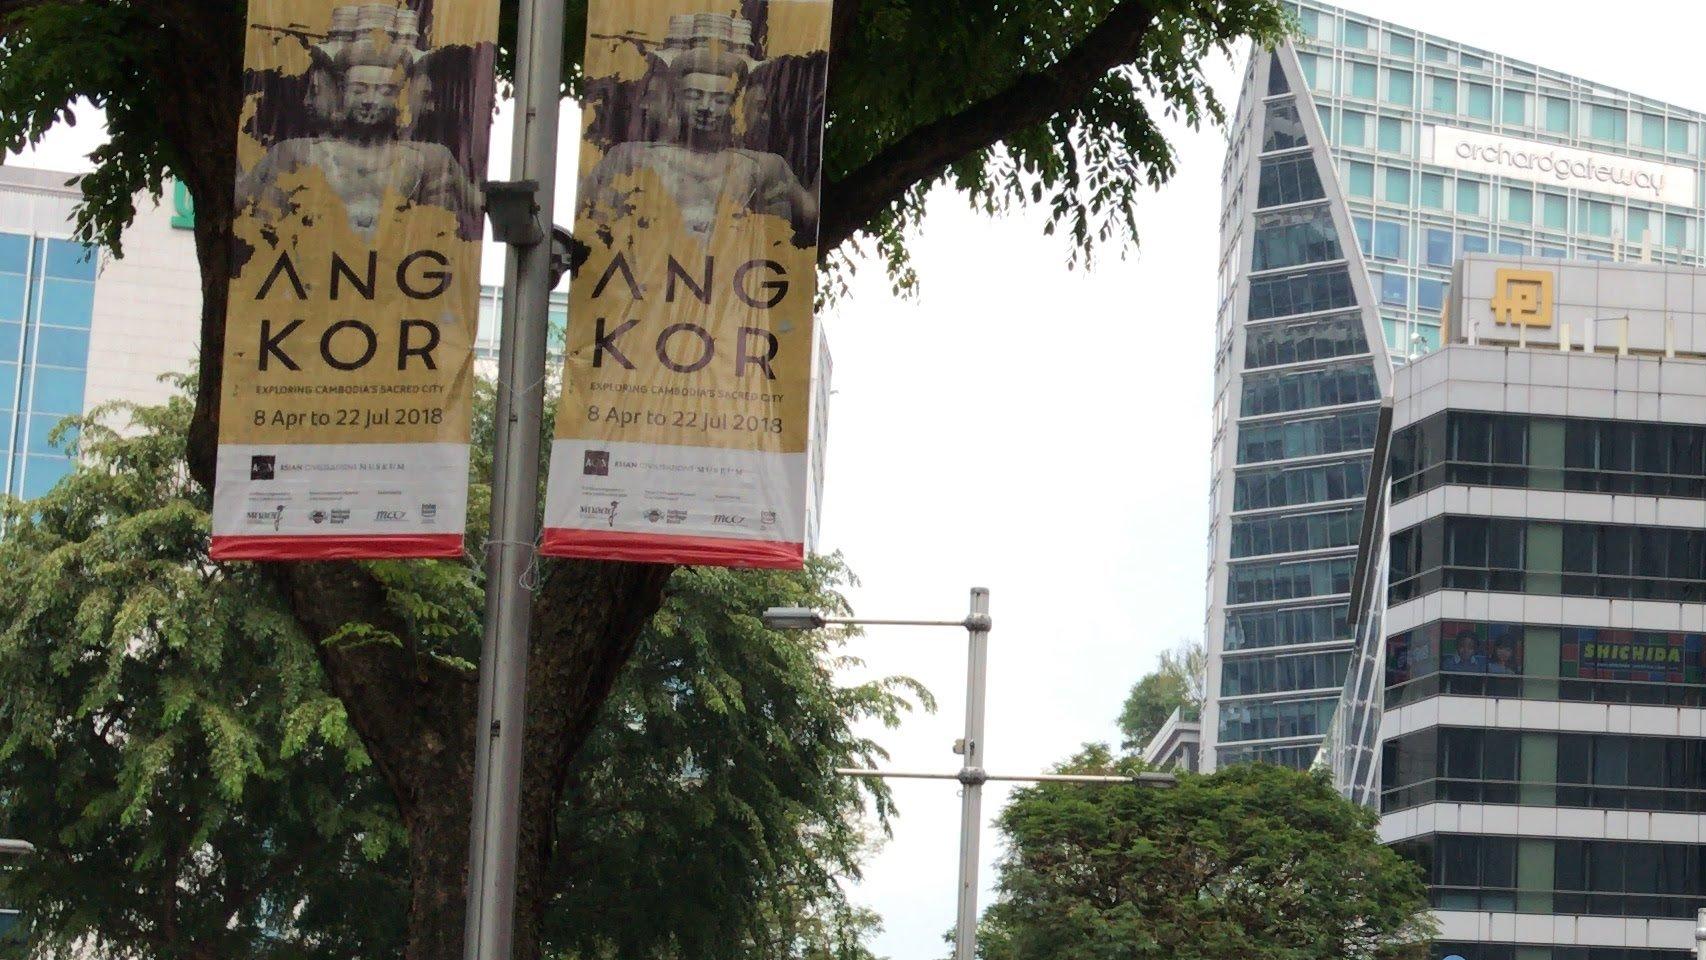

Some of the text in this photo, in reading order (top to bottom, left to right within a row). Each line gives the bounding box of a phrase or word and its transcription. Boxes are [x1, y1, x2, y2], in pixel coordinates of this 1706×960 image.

[1456, 140, 1665, 197] orchardgateway
[255, 250, 453, 301] ANG
[591, 250, 790, 309] ANG
[258, 319, 441, 372] KOR
[593, 317, 779, 380] KOR
[255, 385, 313, 394] EXPLORING
[380, 384, 420, 394] SACRED
[421, 384, 445, 393] CITY
[590, 381, 648, 394] EXPLORING
[717, 389, 759, 401] SACRED
[760, 393, 785, 403] CITY
[254, 408, 443, 430] 8 Apr to 22 Jul 2018
[587, 405, 783, 434] 8 Apr to 22 Jul 2018
[1583, 642, 1681, 663] SHICHIDA
